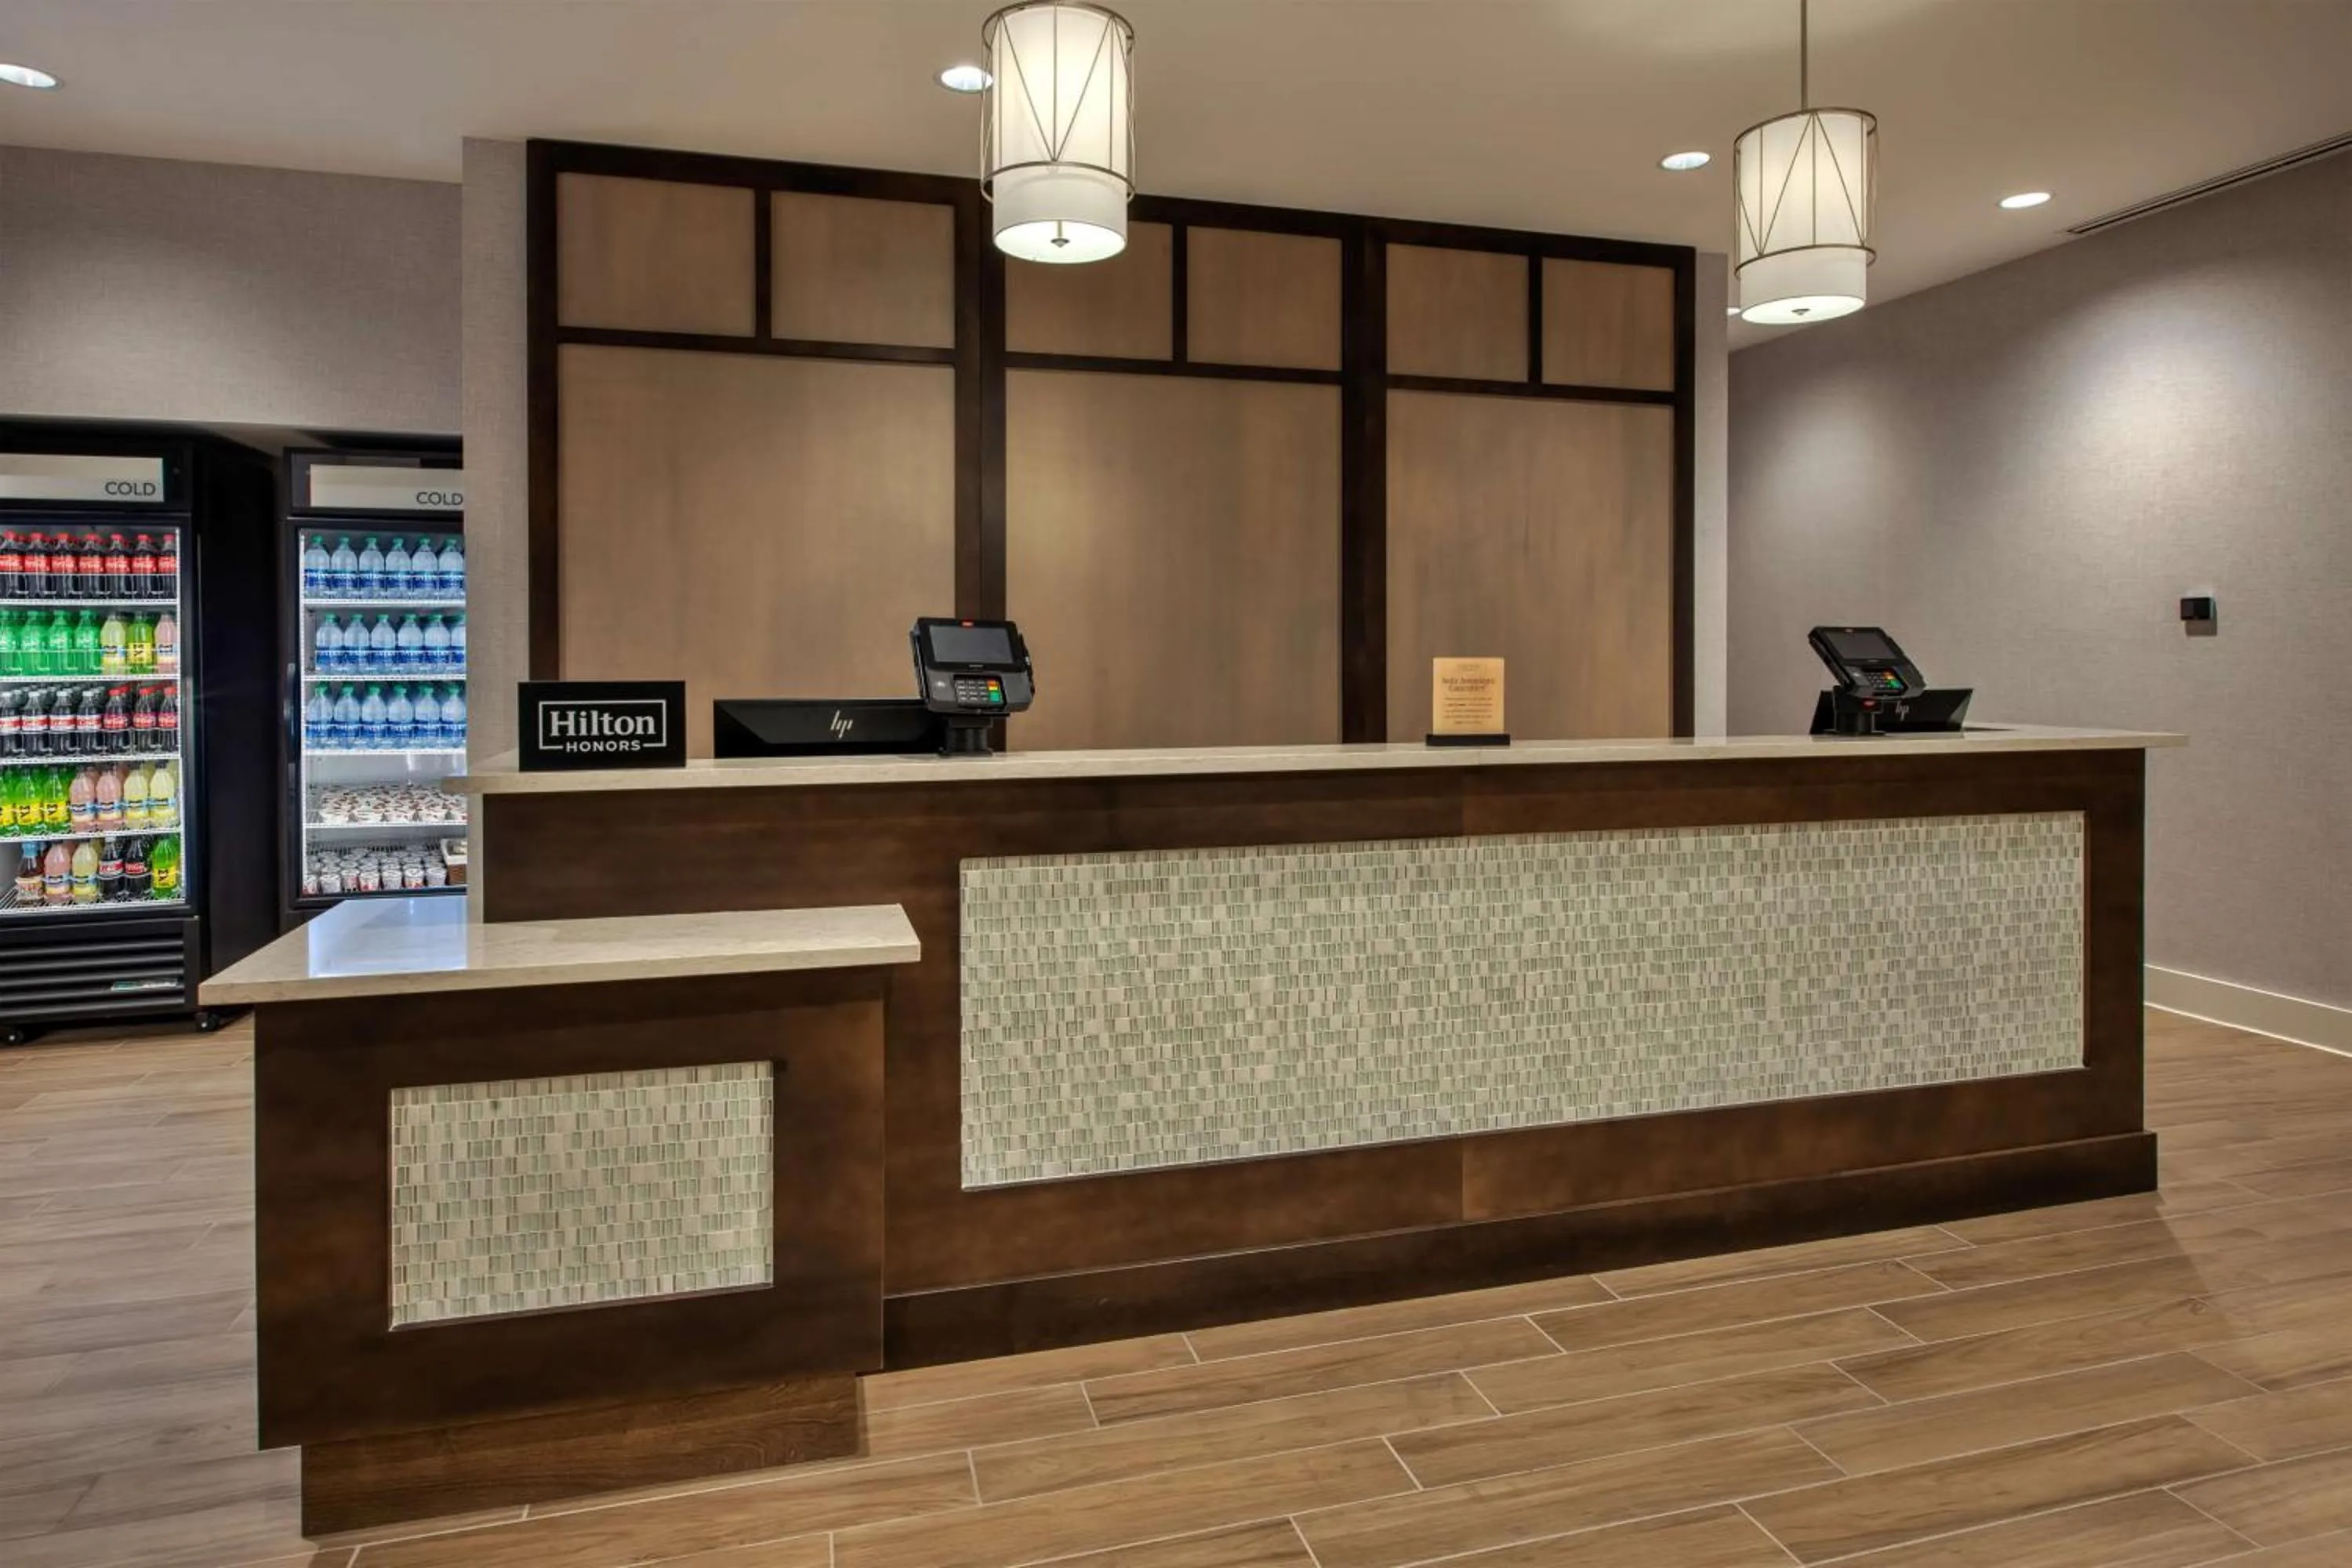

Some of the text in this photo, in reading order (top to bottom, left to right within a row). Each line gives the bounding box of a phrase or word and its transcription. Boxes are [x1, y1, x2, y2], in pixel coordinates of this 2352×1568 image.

[104, 481, 156, 496] COLD
[416, 492, 463, 506] COLD
[550, 710, 657, 737] Hilton
[829, 709, 853, 739] hp
[566, 739, 641, 753] HONORS
